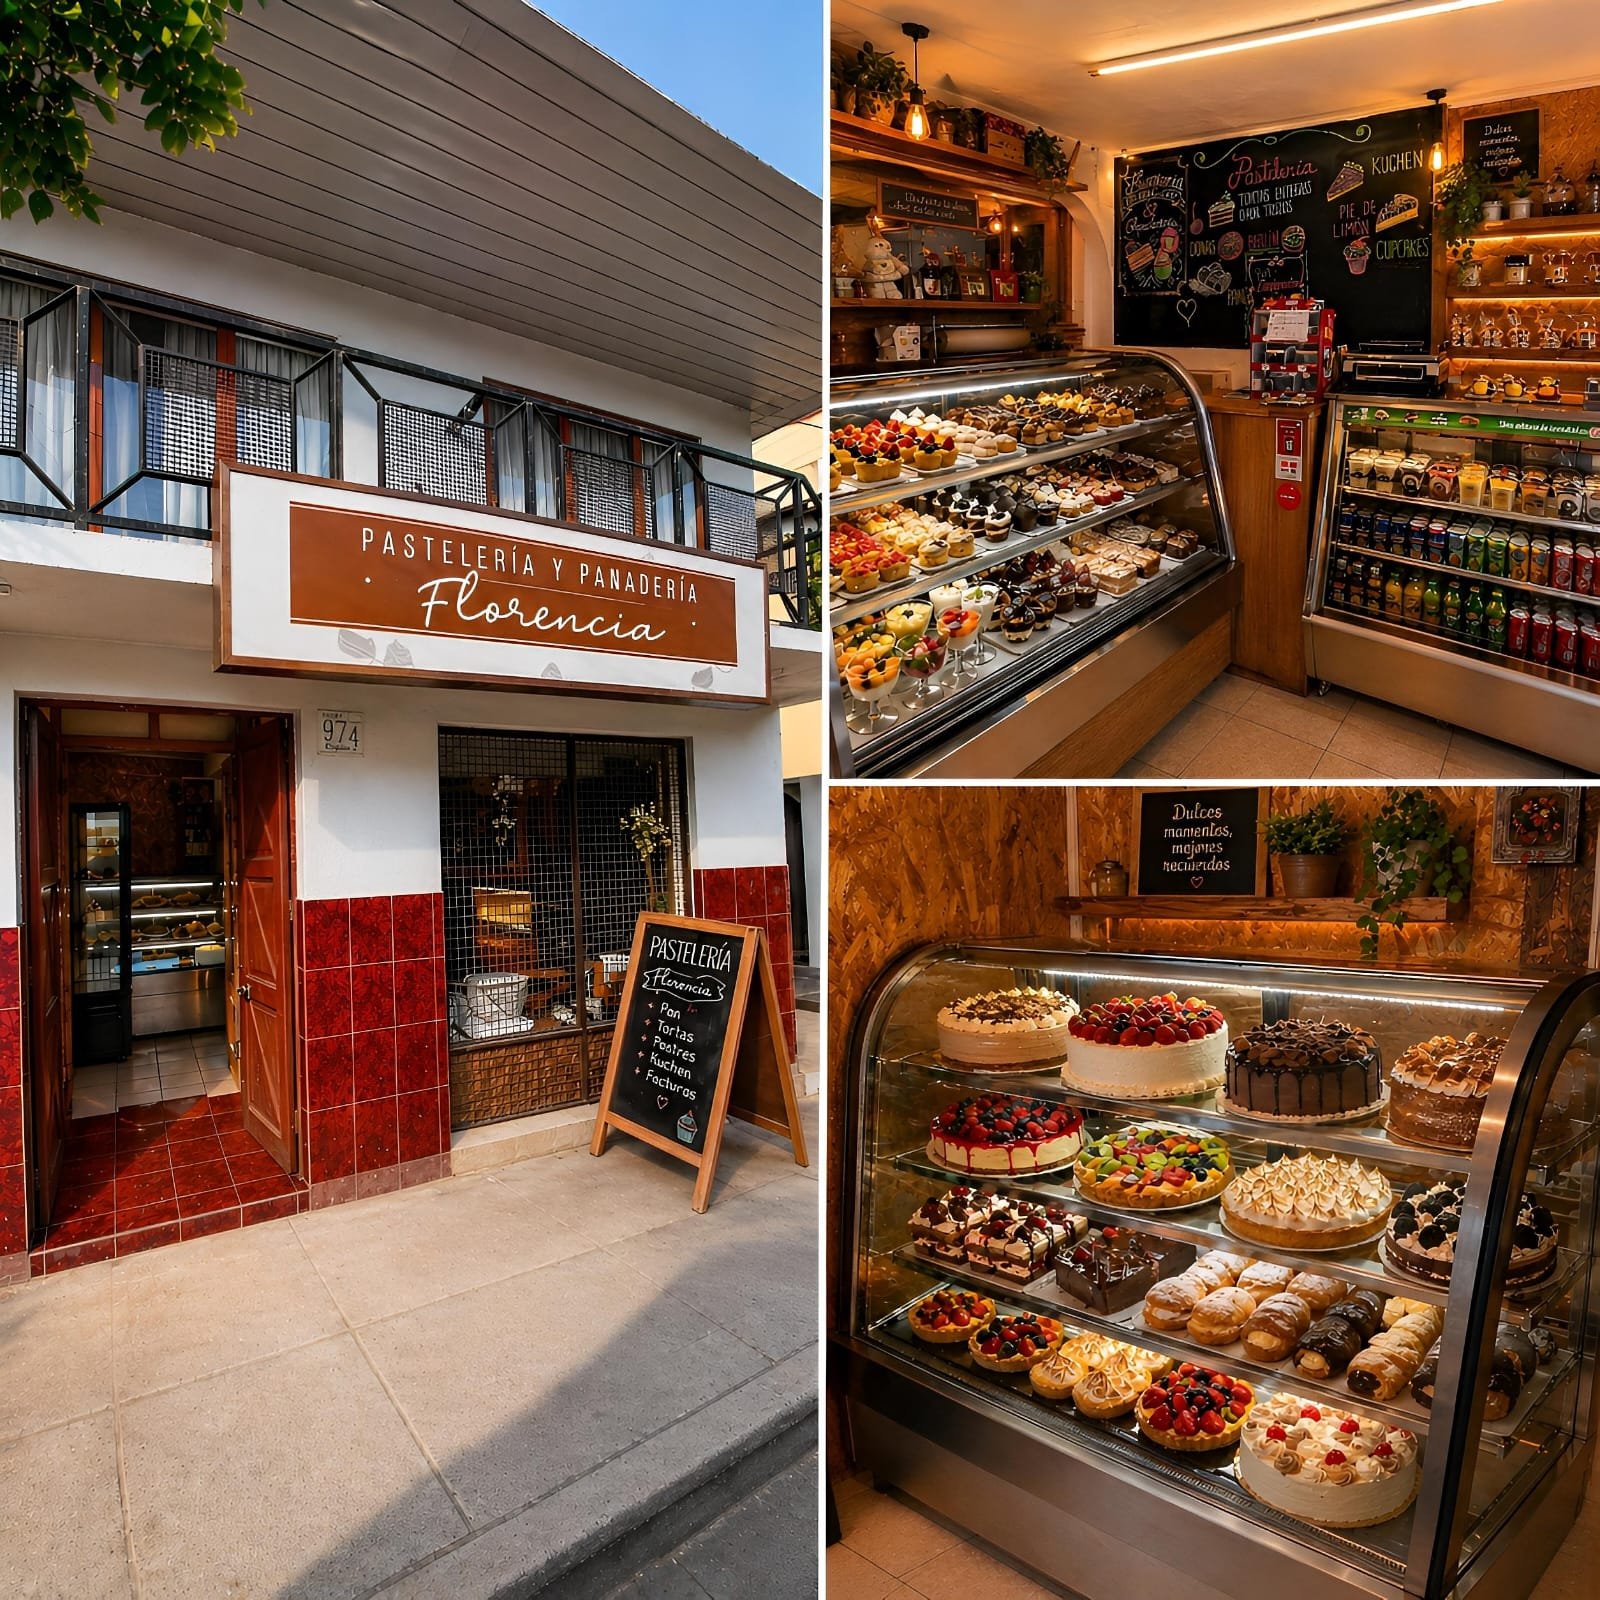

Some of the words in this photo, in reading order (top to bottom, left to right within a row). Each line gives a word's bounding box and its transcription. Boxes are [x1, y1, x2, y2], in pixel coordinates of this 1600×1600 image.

[1372, 150, 1423, 175] KUCHEN
[1340, 203, 1355, 219] PIE
[1364, 200, 1377, 216] DE
[1376, 237, 1430, 260] CUPCAKES
[362, 527, 534, 576] PASTELERÍA
[552, 557, 563, 581] Y
[580, 562, 697, 604] PANADERÍA
[417, 569, 666, 641] Florencia
[323, 719, 359, 748] 974
[1172, 802, 1223, 820] Dulces
[649, 935, 731, 973] PASTELERÍA
[661, 1002, 680, 1020] Pan
[658, 1019, 695, 1043] Tortas
[650, 1051, 692, 1080] Kuchen
[646, 1069, 697, 1101] Facturas
